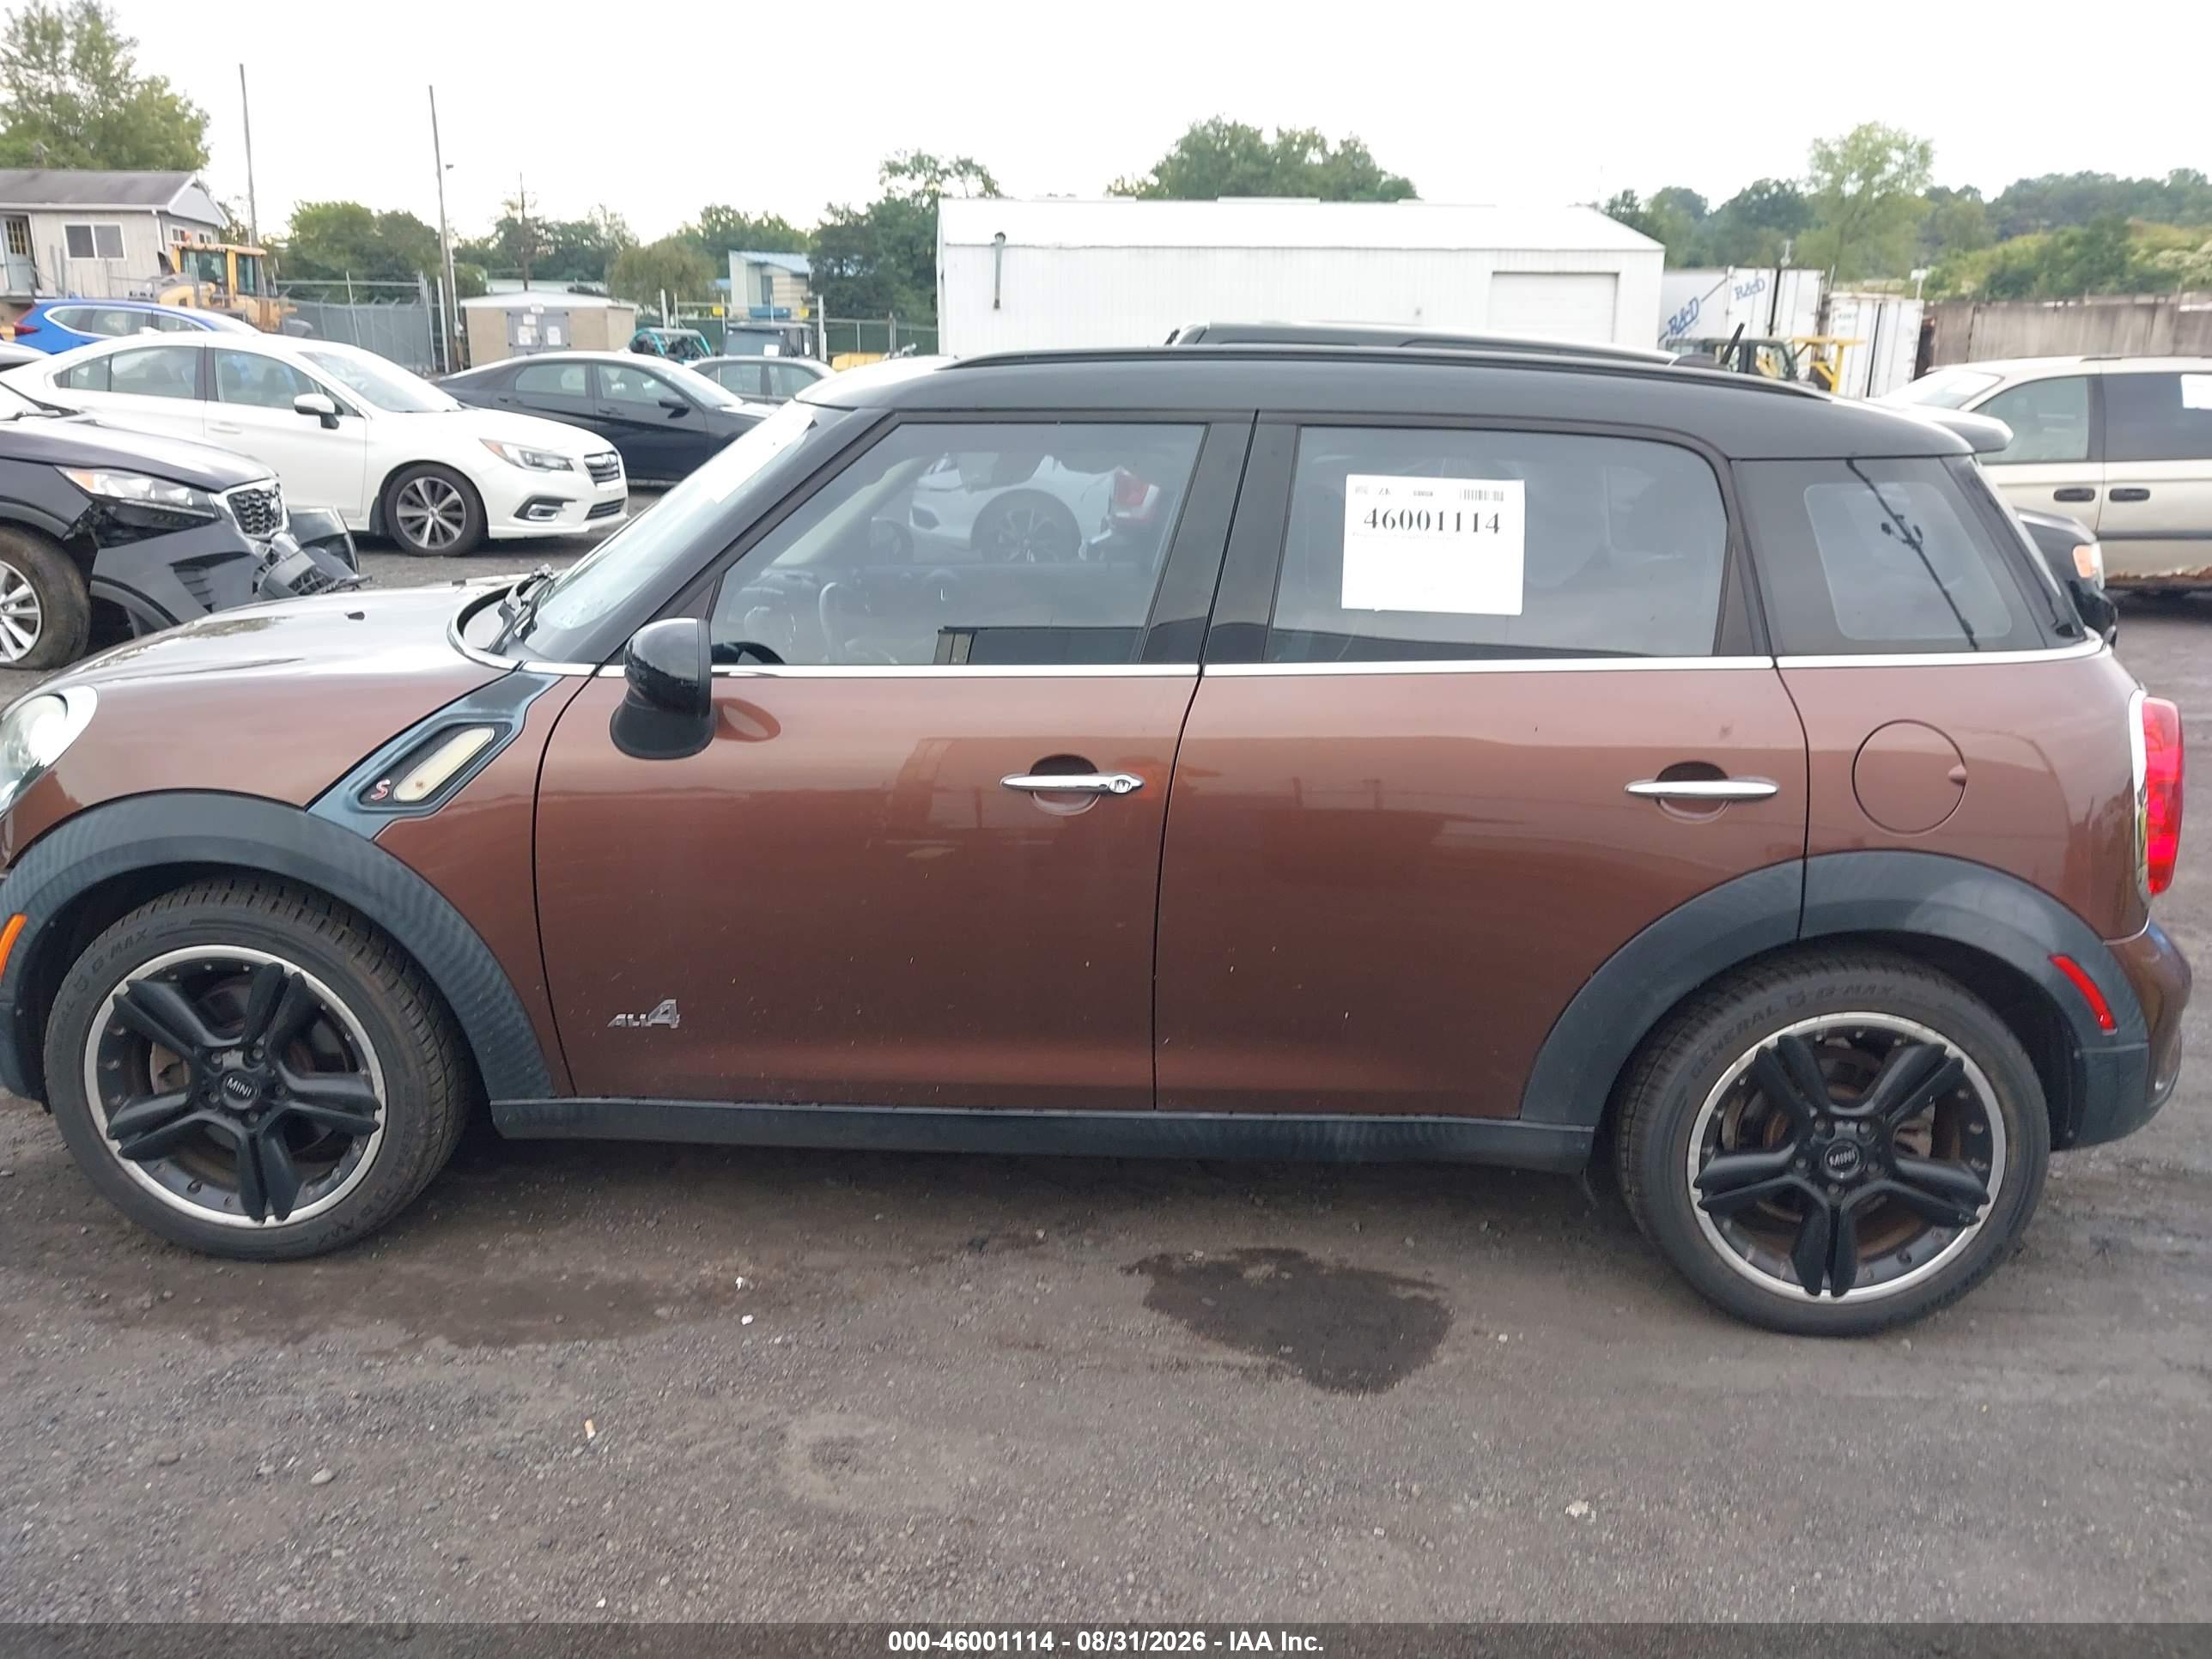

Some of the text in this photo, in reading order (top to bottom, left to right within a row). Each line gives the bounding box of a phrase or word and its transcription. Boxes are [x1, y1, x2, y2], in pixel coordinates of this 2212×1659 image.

[1364, 507, 1501, 534] 46001114
[370, 779, 391, 800] S
[226, 1077, 252, 1098] MINI
[1829, 1149, 1856, 1168] MINI
